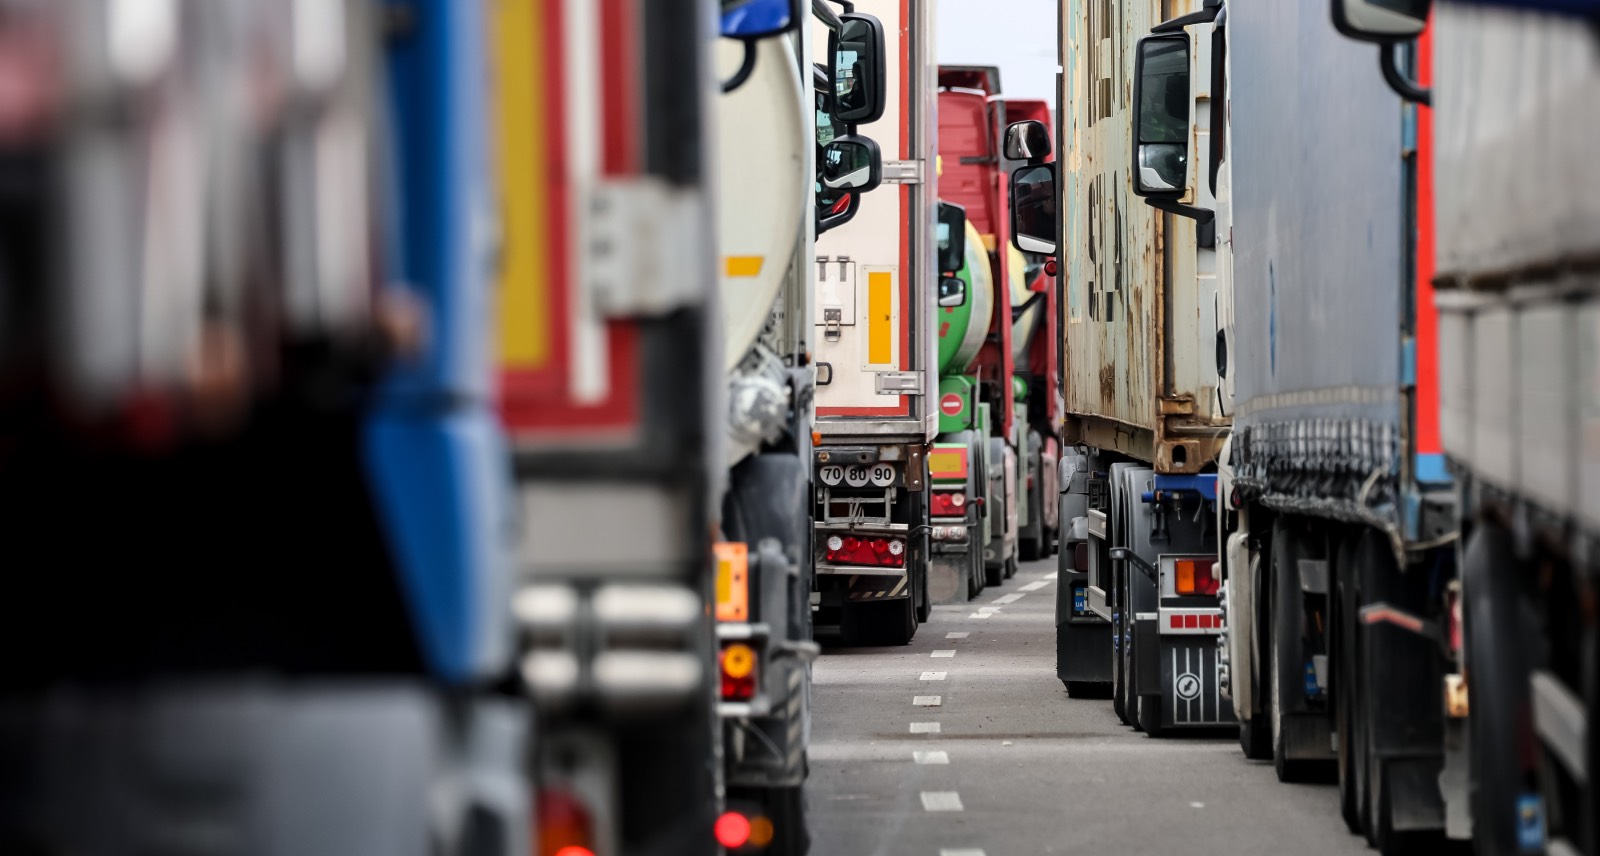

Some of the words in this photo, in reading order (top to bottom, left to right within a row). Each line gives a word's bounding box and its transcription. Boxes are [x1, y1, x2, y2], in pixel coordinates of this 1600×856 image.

[824, 468, 841, 480] 70
[849, 468, 867, 481] 80
[874, 467, 892, 481] 90
